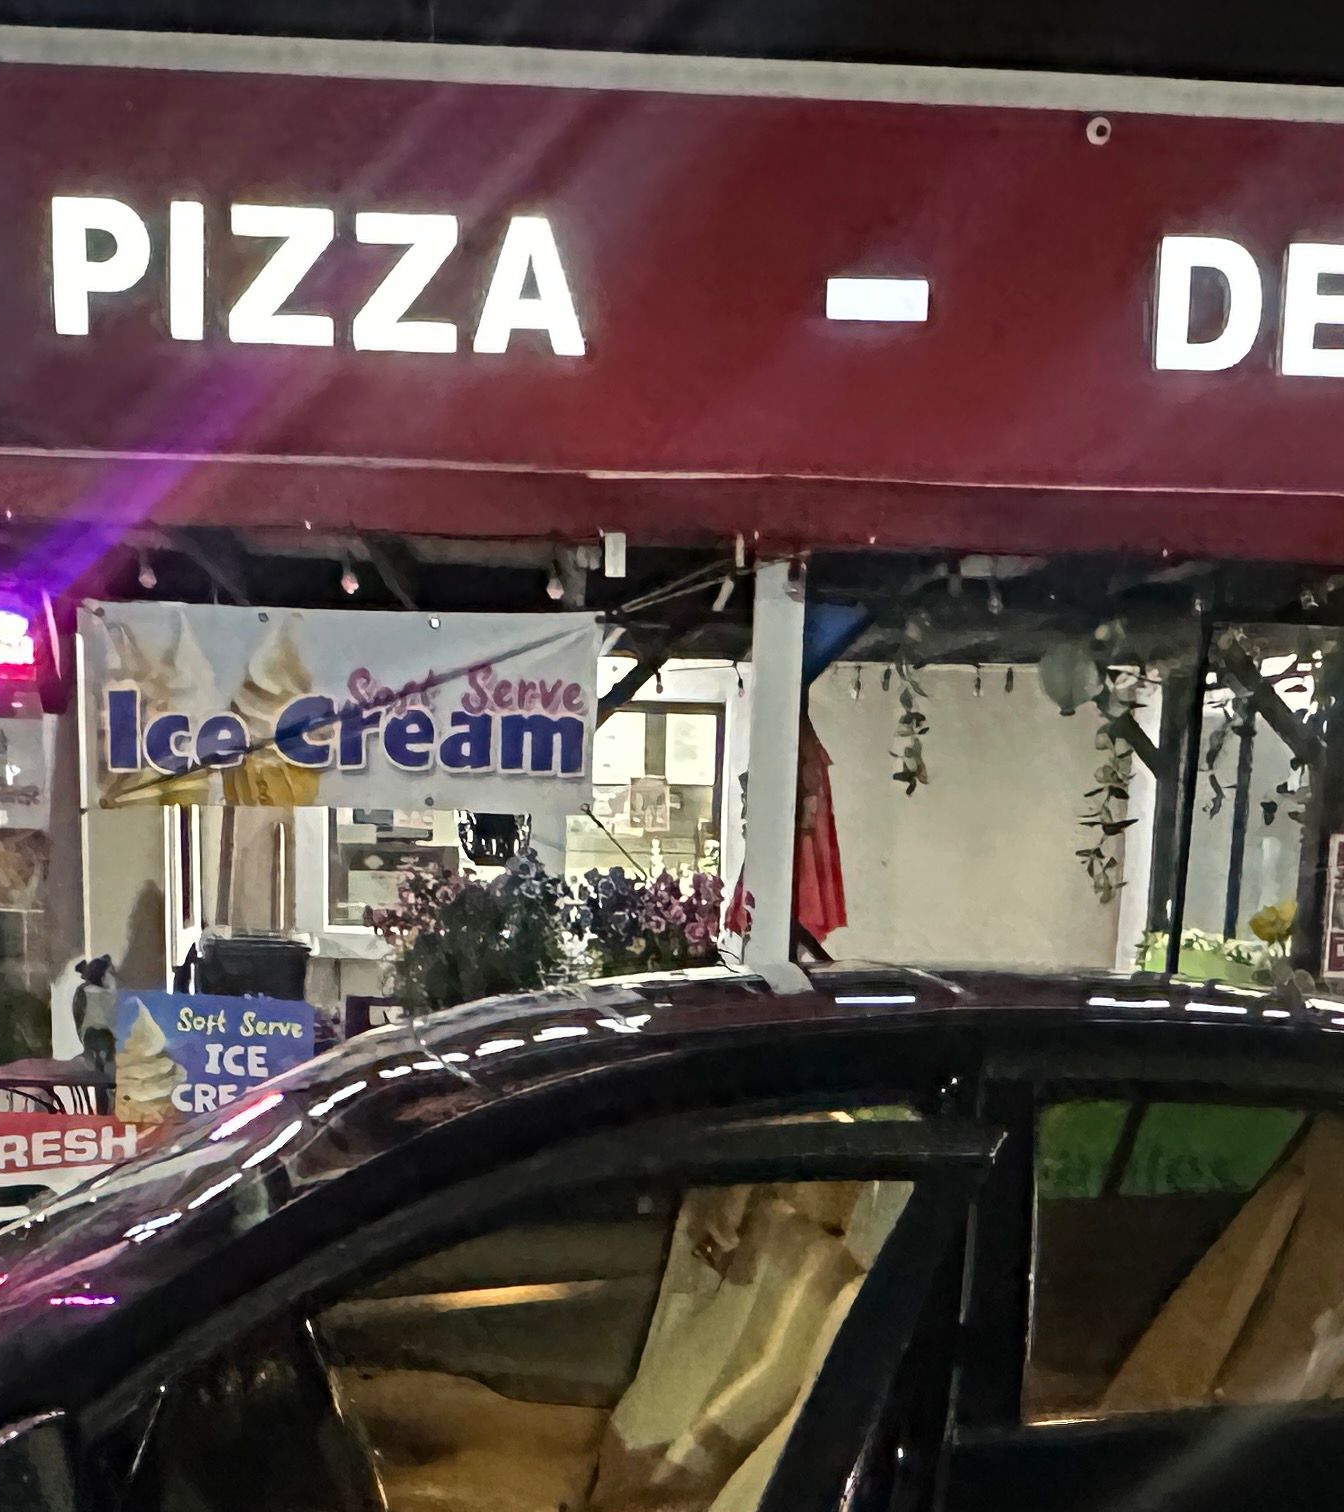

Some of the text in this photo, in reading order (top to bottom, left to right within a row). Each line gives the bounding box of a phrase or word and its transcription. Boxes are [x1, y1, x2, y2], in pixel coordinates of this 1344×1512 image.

[51, 195, 587, 357] PIZZA
[461, 664, 586, 716] Serve
[106, 685, 251, 774] Ice
[274, 694, 587, 777] Cream
[177, 1007, 303, 1038] Soft Serve
[204, 1043, 269, 1078] ICE
[170, 1083, 256, 1113] CRE
